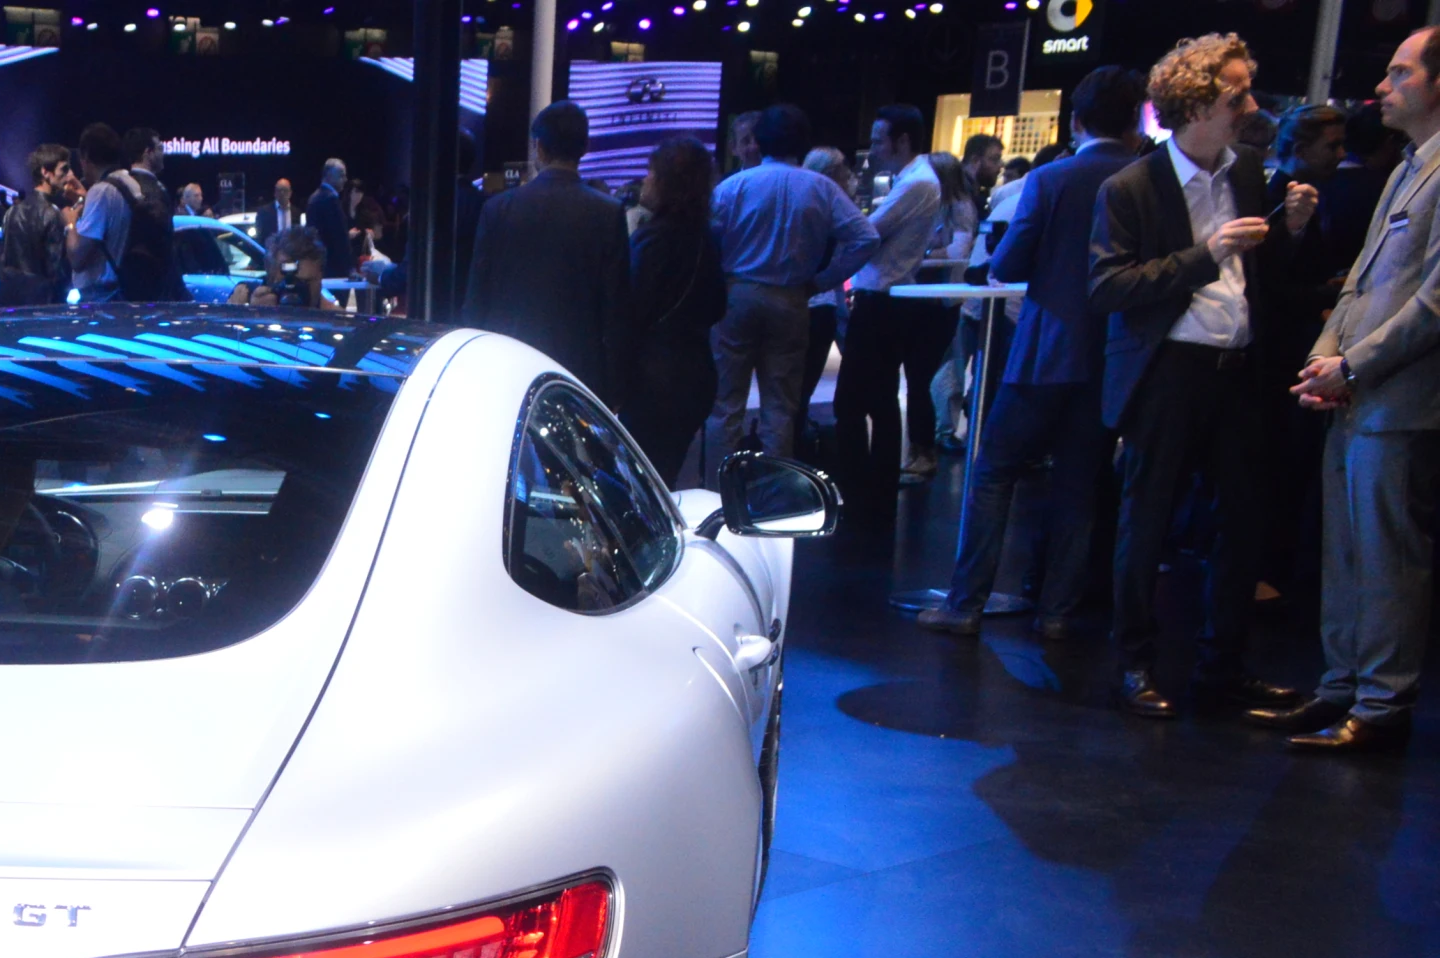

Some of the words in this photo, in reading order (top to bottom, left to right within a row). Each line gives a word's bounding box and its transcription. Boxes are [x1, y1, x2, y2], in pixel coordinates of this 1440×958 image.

[1042, 35, 1089, 54] smart
[985, 50, 1009, 89] B
[162, 137, 200, 158] ushing
[202, 137, 219, 154] All
[221, 137, 290, 154] Boundaries
[13, 903, 91, 927] GT
